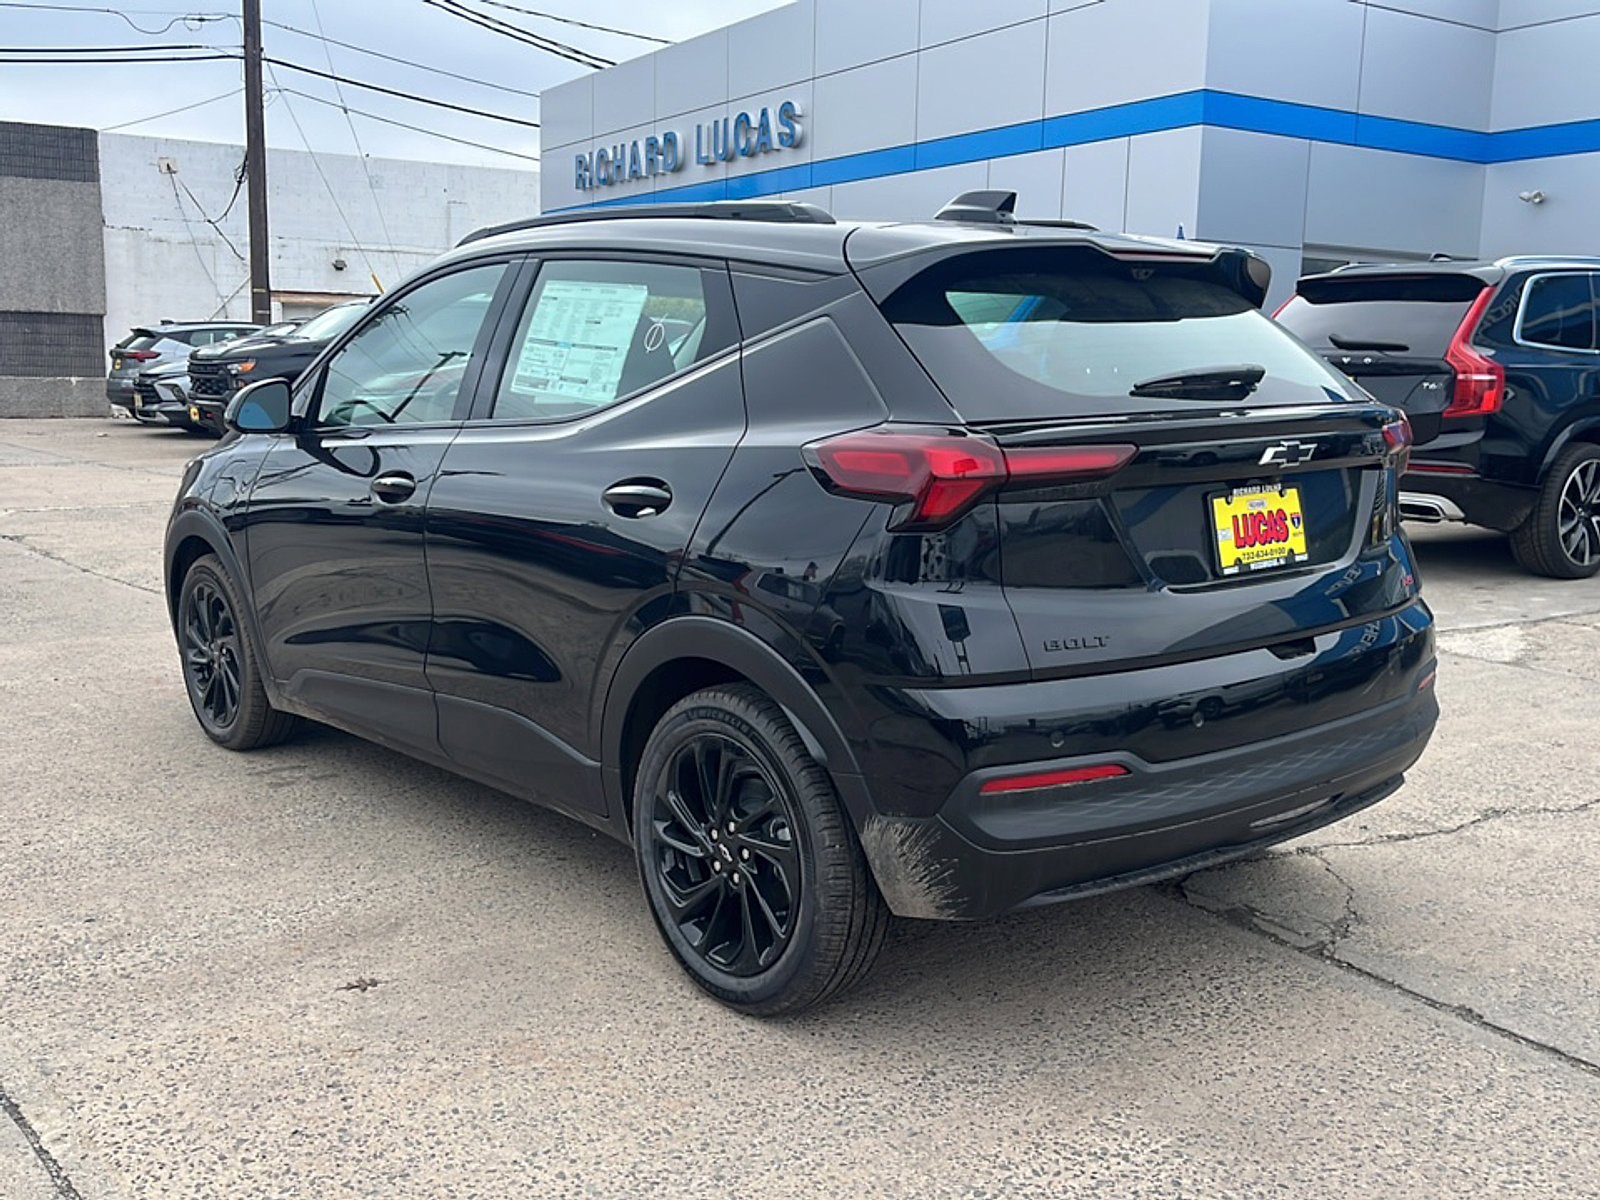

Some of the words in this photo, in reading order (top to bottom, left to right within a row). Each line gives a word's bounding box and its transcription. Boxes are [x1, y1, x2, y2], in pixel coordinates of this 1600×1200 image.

[575, 131, 684, 191] RICHARD
[696, 100, 806, 166] LUCAS
[1232, 507, 1289, 549] LUCAS
[1043, 635, 1110, 653] BOLT
